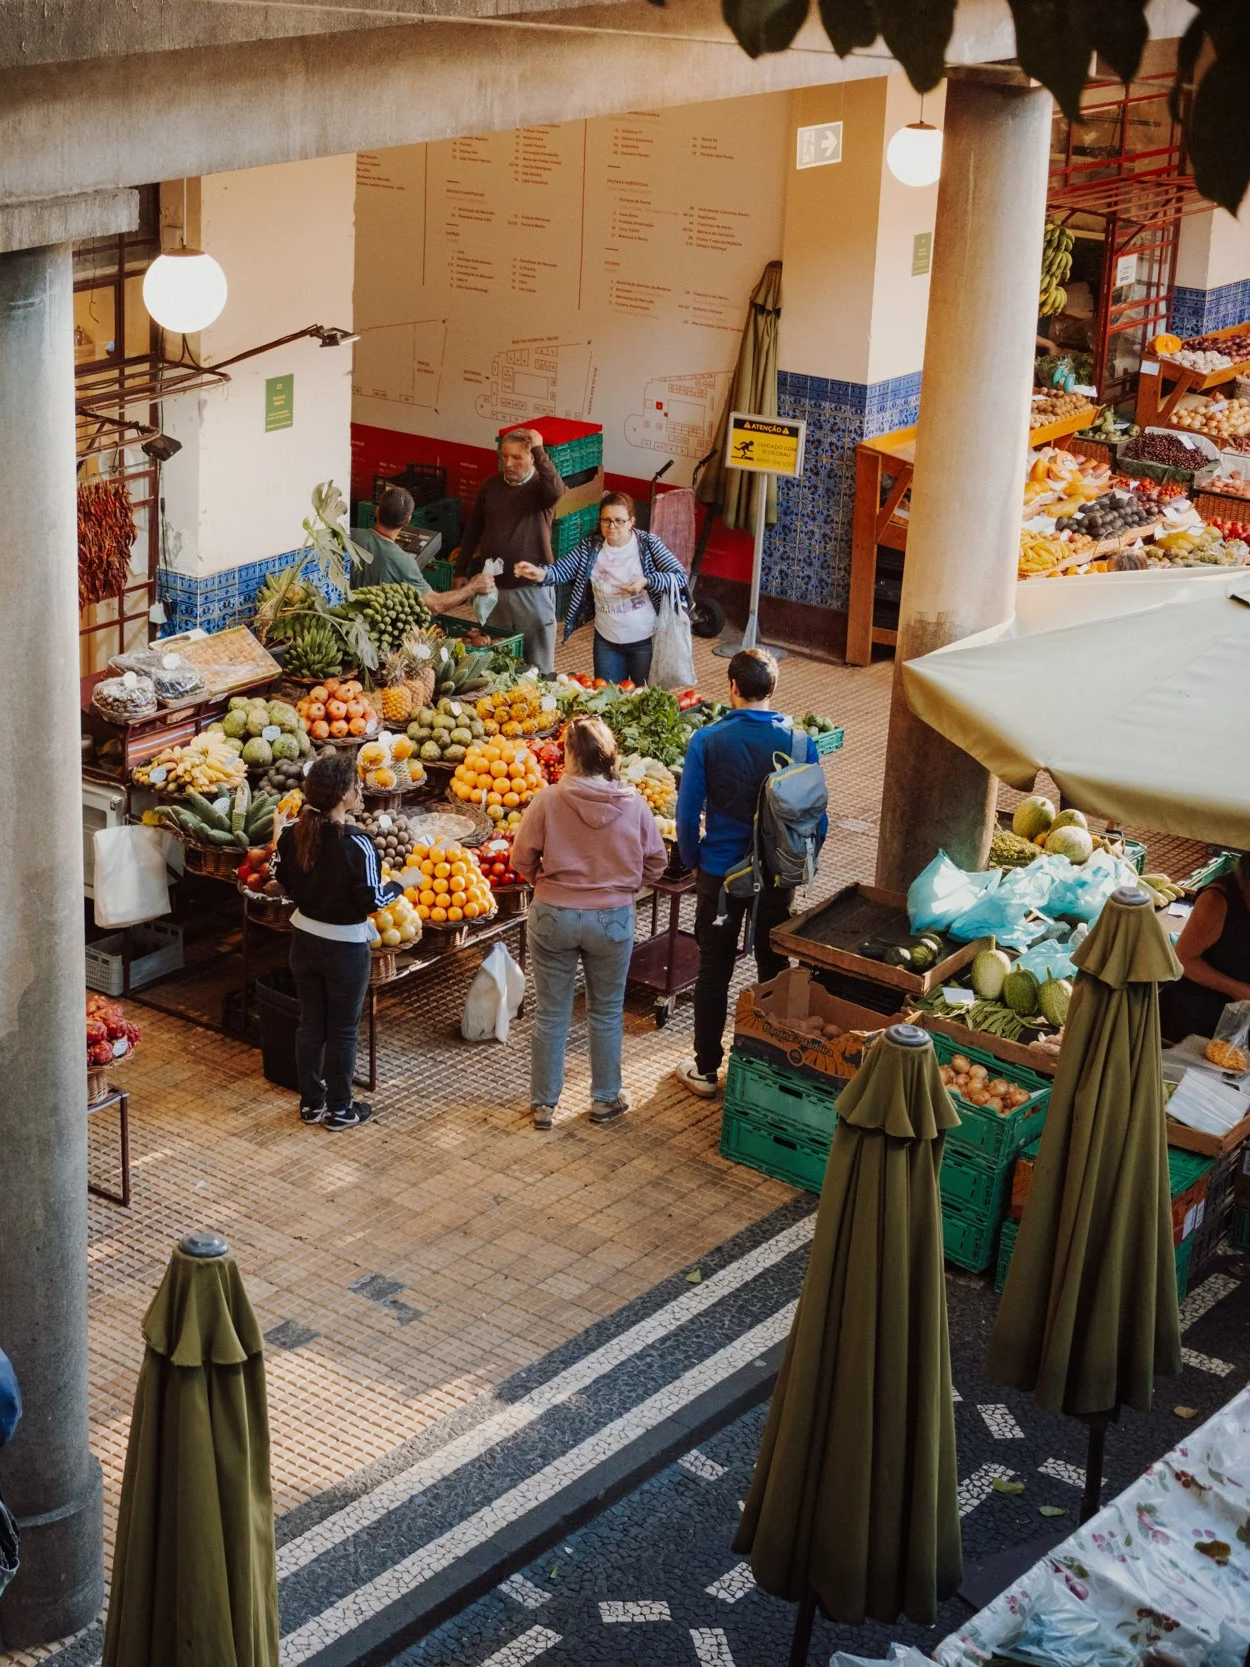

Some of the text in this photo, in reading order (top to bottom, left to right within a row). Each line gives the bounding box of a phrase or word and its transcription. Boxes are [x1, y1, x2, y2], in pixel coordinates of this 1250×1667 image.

[751, 423, 782, 433] ATENÇÃO
[764, 1022, 833, 1057] Banana Madeira
